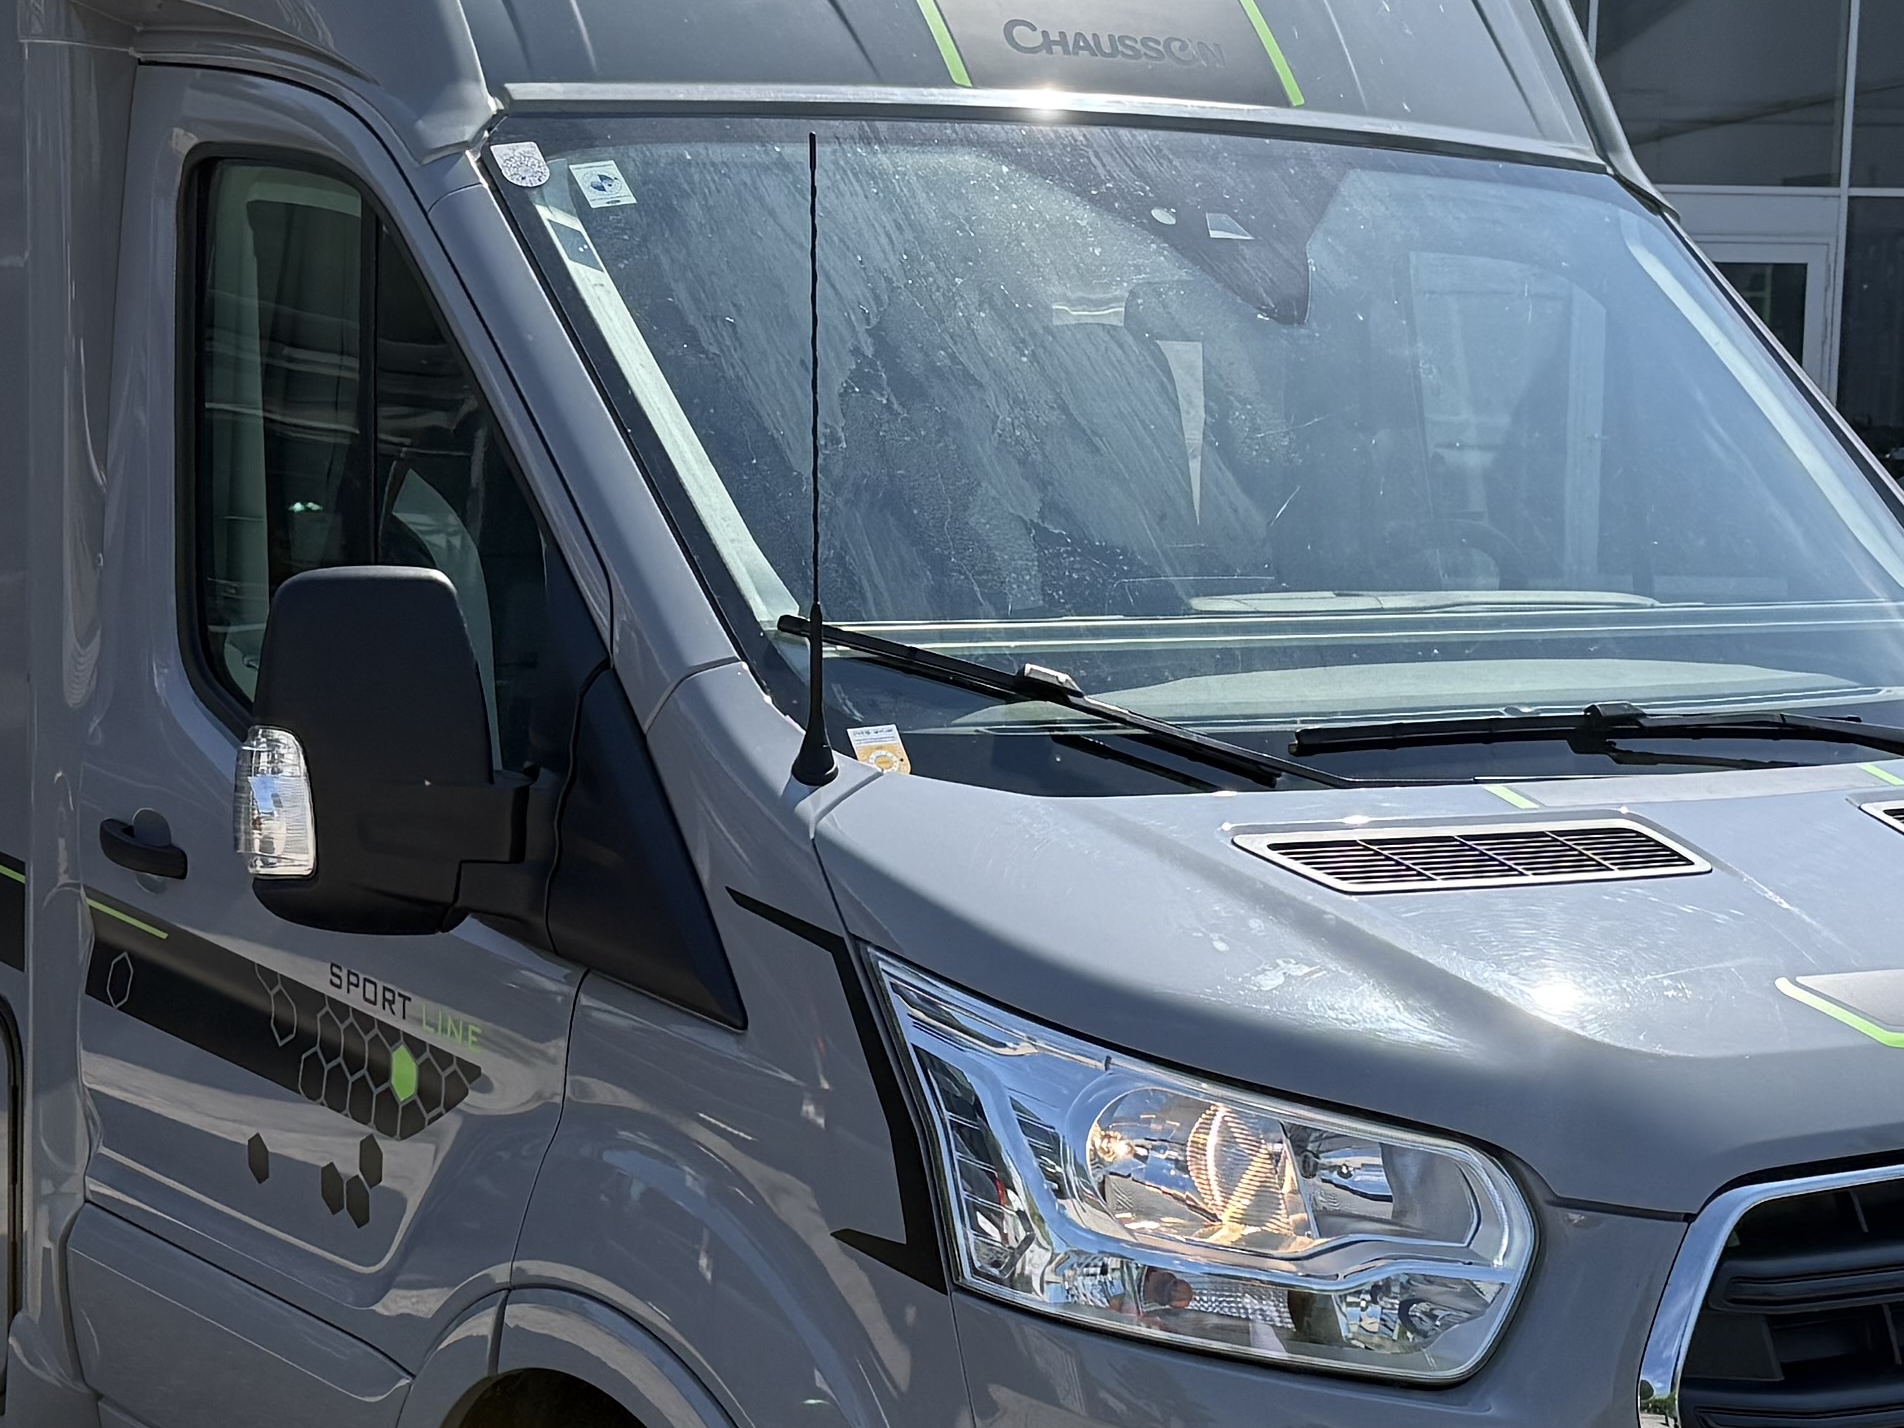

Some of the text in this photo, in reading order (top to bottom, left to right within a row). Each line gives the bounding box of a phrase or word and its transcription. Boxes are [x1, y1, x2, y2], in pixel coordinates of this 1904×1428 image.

[1003, 18, 1226, 69] CHAUSSON
[329, 962, 482, 1053] SPORT LINE
